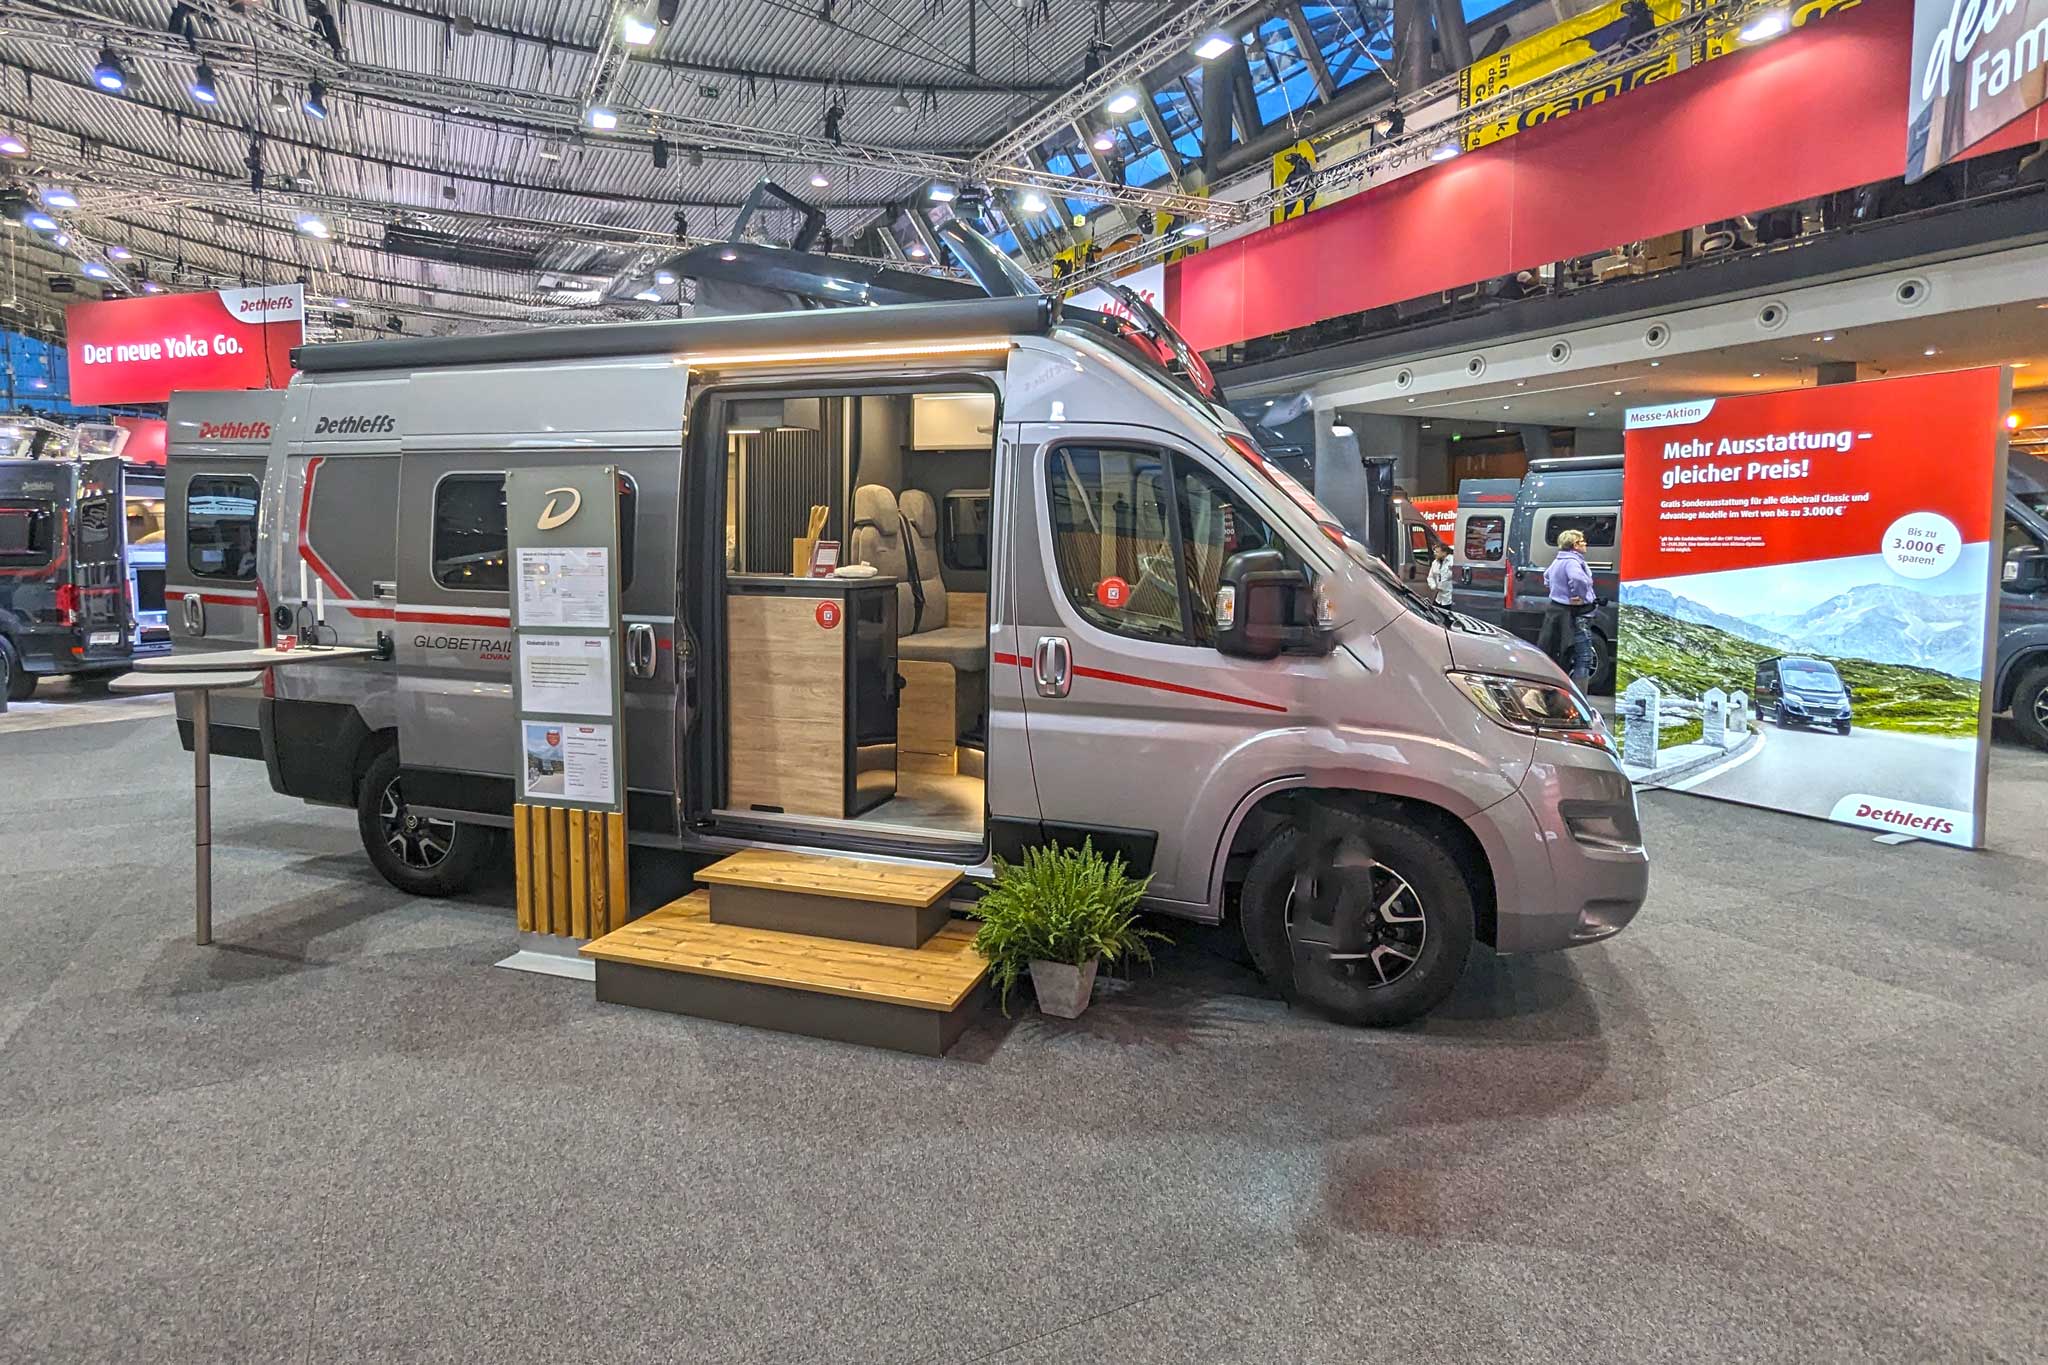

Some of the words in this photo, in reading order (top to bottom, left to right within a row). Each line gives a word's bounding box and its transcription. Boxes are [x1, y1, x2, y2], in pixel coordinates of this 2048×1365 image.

[239, 296, 294, 313] Dethleffs
[84, 342, 113, 365] Der
[117, 344, 161, 363] neue
[164, 334, 208, 358] Yoka
[213, 333, 243, 355] Go.
[1629, 406, 1701, 423] Messe-Aktion
[198, 421, 272, 440] Dethleffs
[314, 414, 396, 434] Dethleffs
[1663, 438, 1713, 460] Mehr
[1716, 430, 1852, 456] Ausstattung
[1661, 463, 1742, 489] gleicher
[1746, 459, 1809, 481] Preis!
[1660, 500, 1681, 509] Gratis
[1681, 498, 1749, 508] Sonderausstattung
[1750, 496, 1762, 505] für
[1763, 496, 1778, 504] alle
[1780, 494, 1820, 504] Globetrail
[1821, 493, 1850, 502] Classic
[1851, 492, 1869, 502] und
[1660, 511, 1698, 521] Advantage
[1698, 510, 1728, 519] Modelle
[1729, 510, 1739, 518] im
[1740, 510, 1759, 518] Wert
[1776, 508, 1789, 517] bis
[1790, 509, 1801, 517] zu
[1907, 527, 1922, 537] Bis
[1925, 530, 1937, 538] zu
[1897, 554, 1935, 566] sparen!
[1855, 803, 1954, 834] Dethleffs
